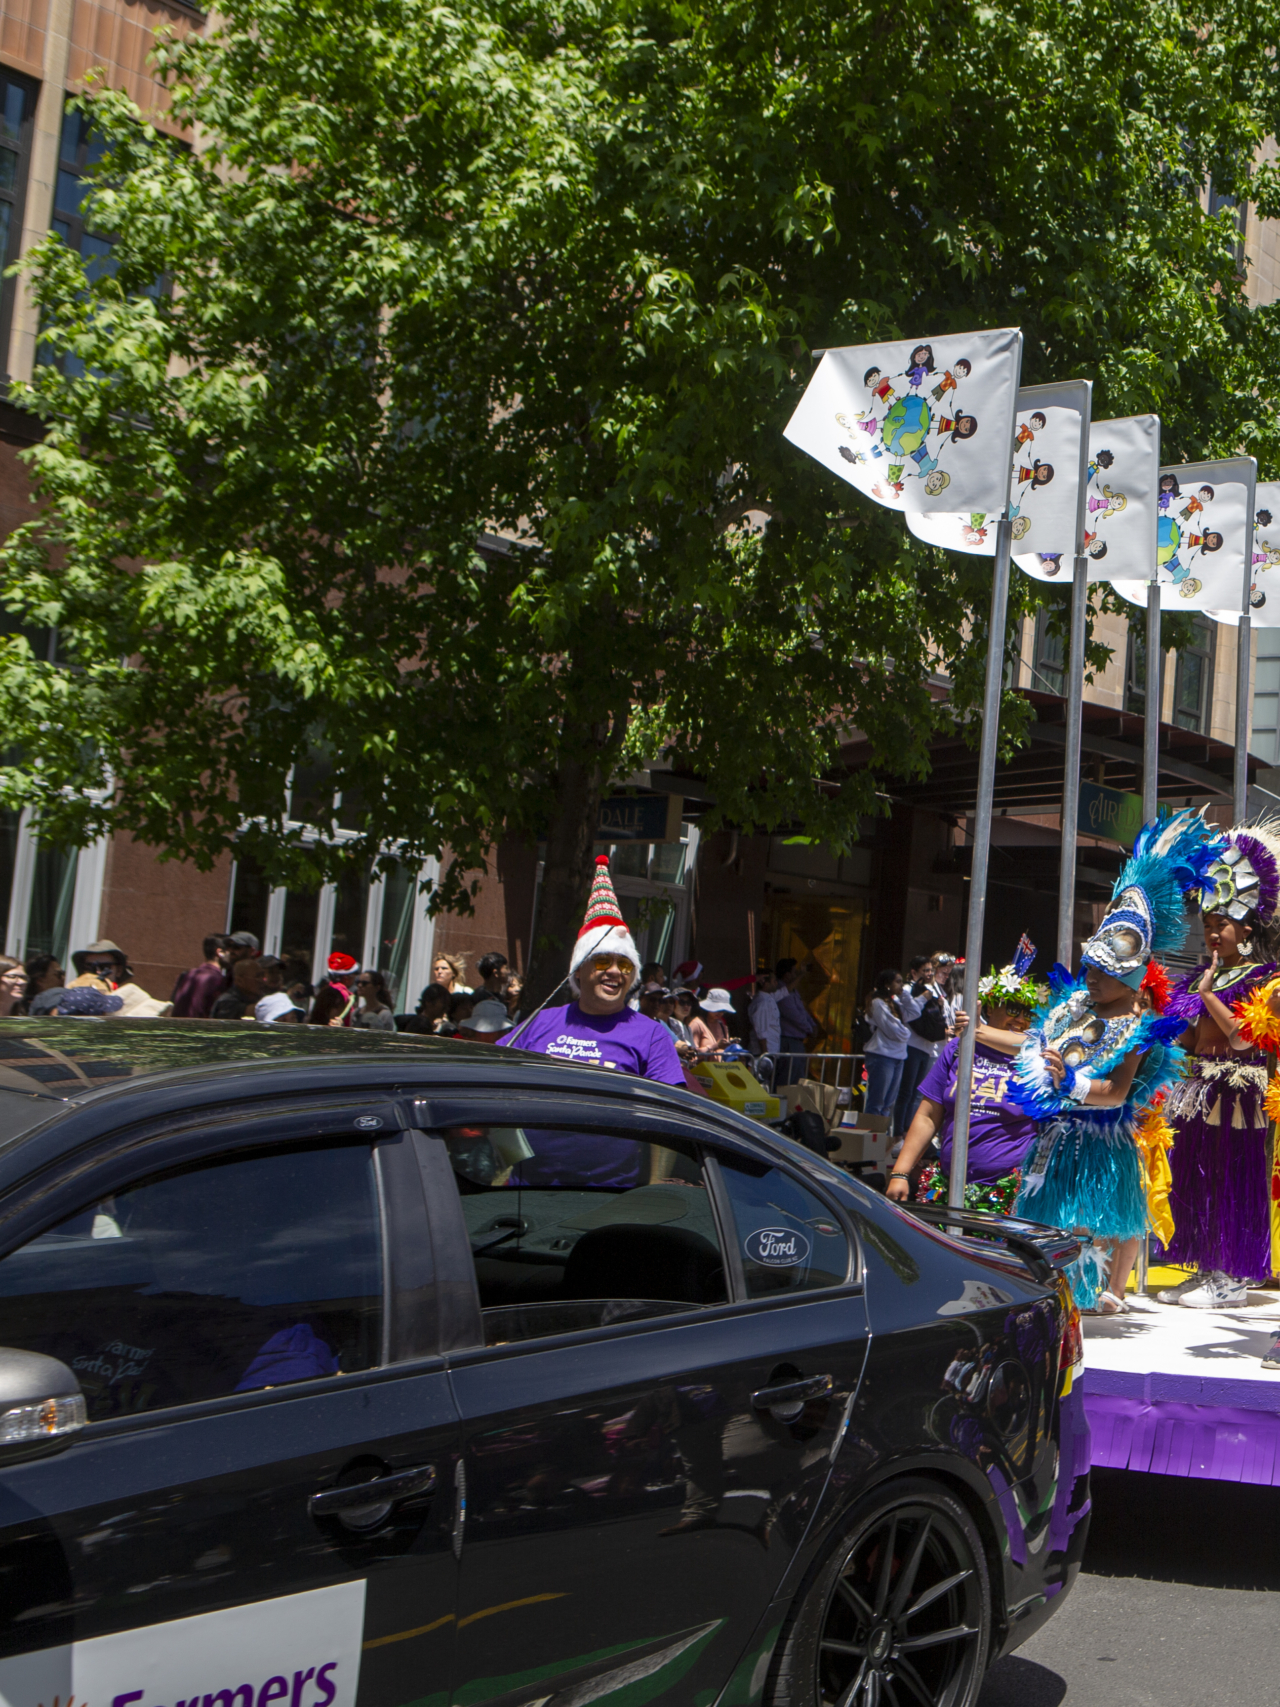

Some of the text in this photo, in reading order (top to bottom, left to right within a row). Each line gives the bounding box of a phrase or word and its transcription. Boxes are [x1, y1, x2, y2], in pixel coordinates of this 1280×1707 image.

[600, 806, 644, 825] DALE
[546, 1042, 602, 1058] Santa Parade
[566, 1036, 597, 1047] Farmers
[759, 1231, 797, 1256] Ford
[112, 1661, 338, 1707] mers
